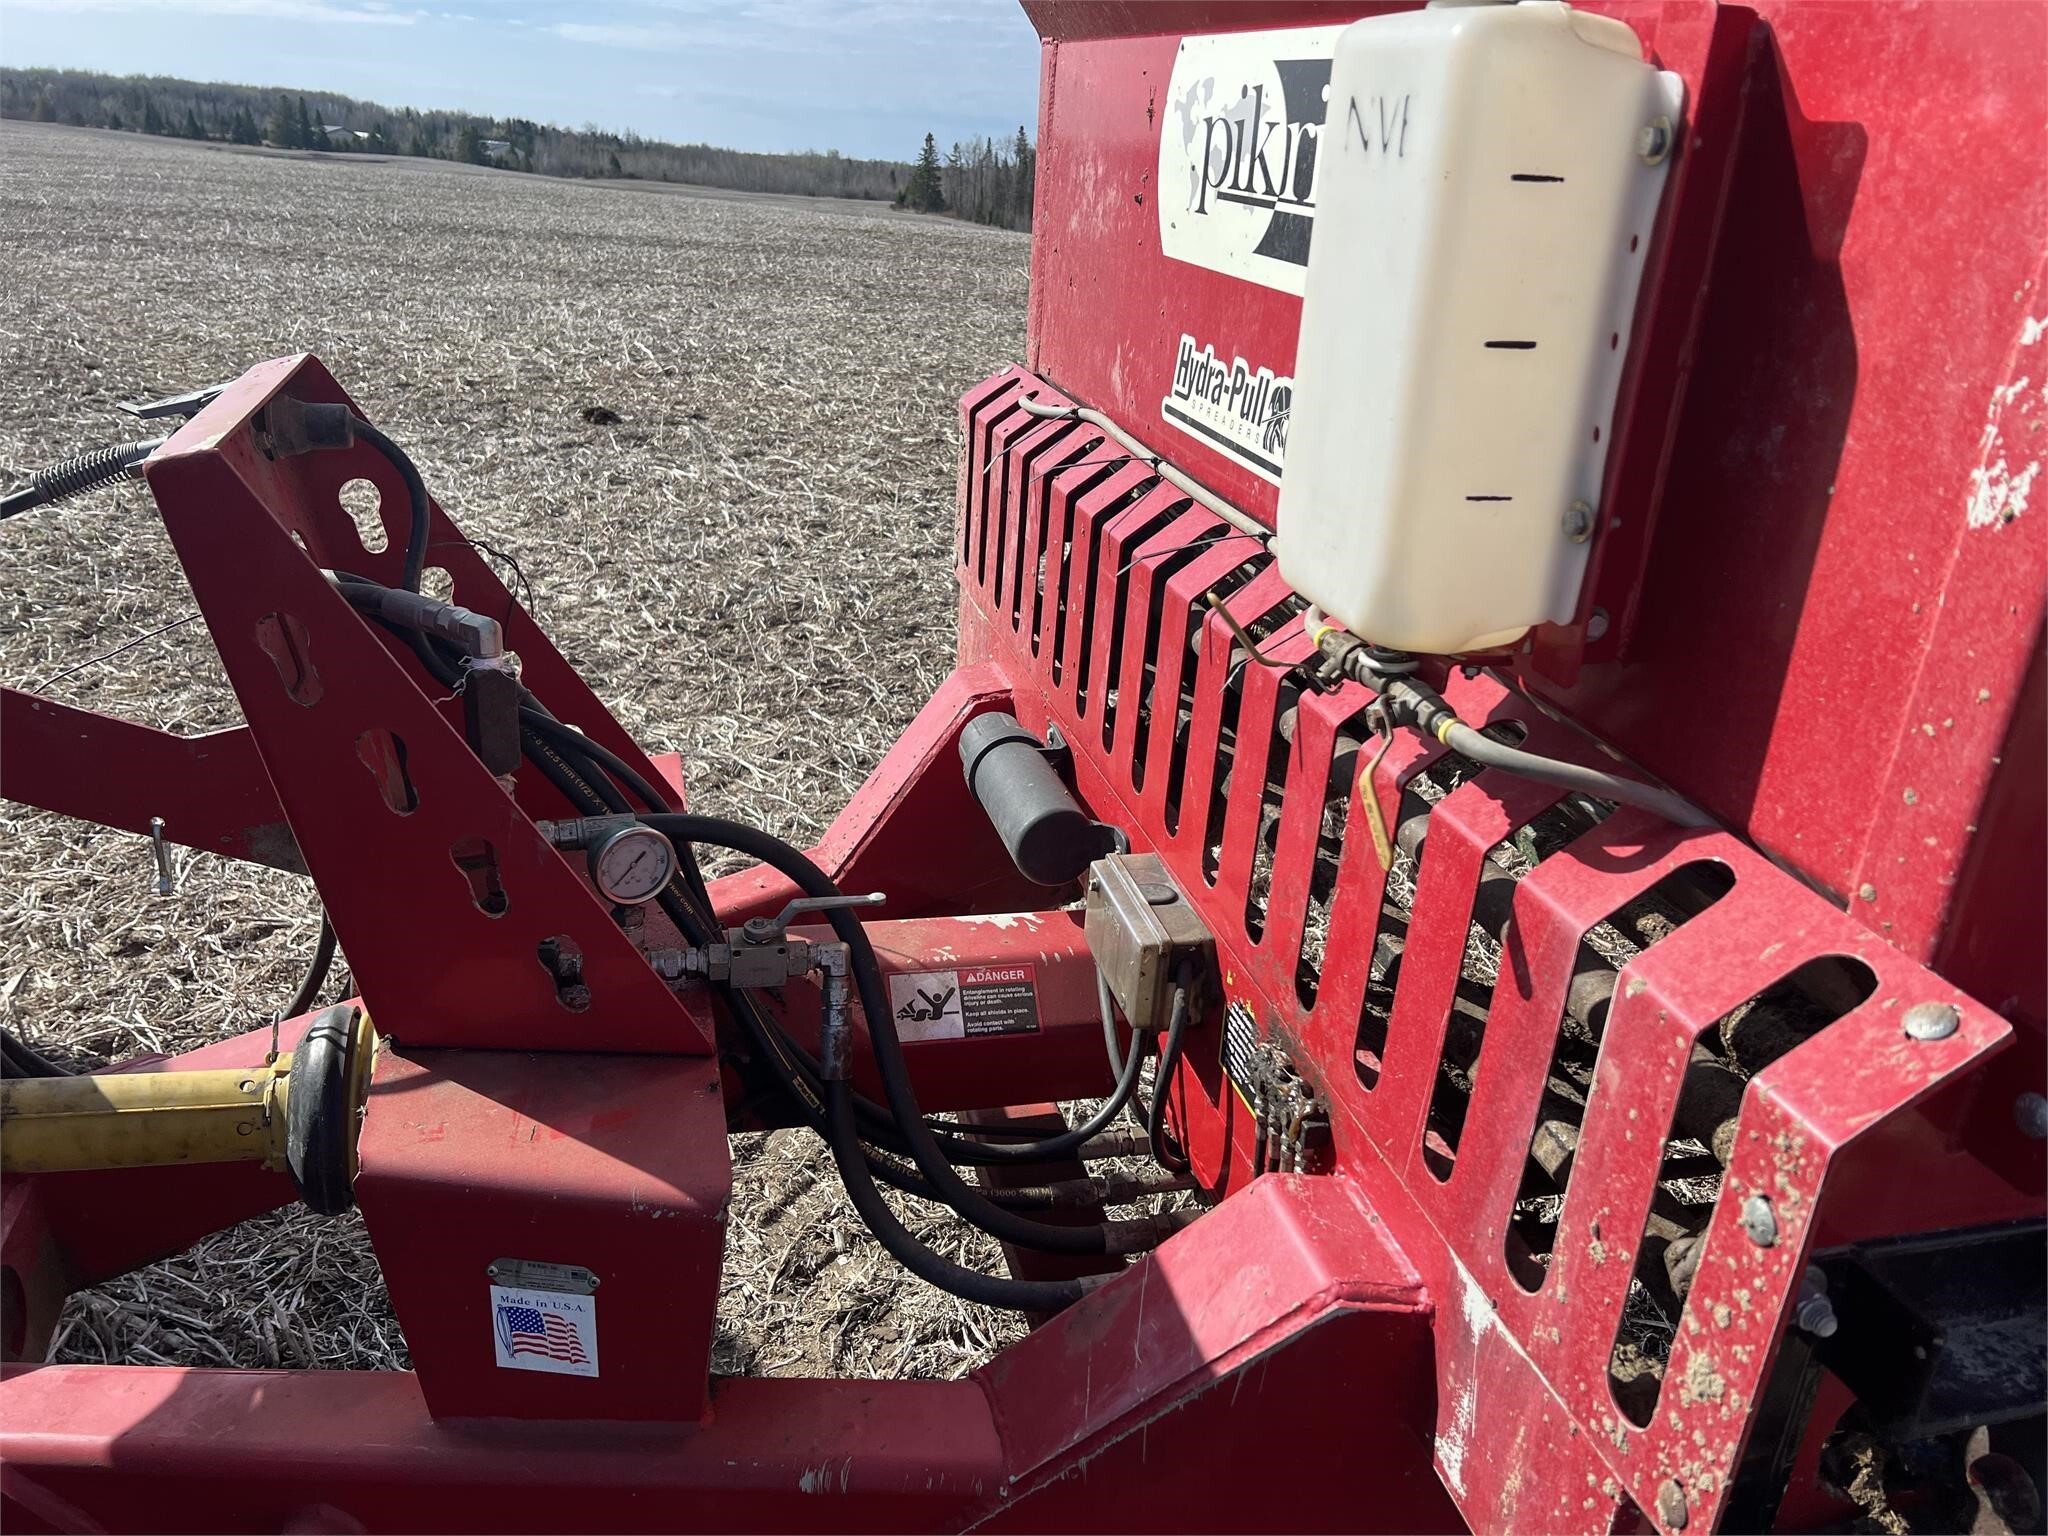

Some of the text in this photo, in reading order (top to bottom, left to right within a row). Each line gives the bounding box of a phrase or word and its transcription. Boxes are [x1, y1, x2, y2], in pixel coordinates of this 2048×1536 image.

[1174, 341, 1270, 427] Hydra-Pull
[1191, 399, 1260, 444] SPREADERS
[559, 762, 575, 779] mm
[976, 970, 1025, 982] DANGER
[500, 1295, 586, 1313] Made in U.S.A.
